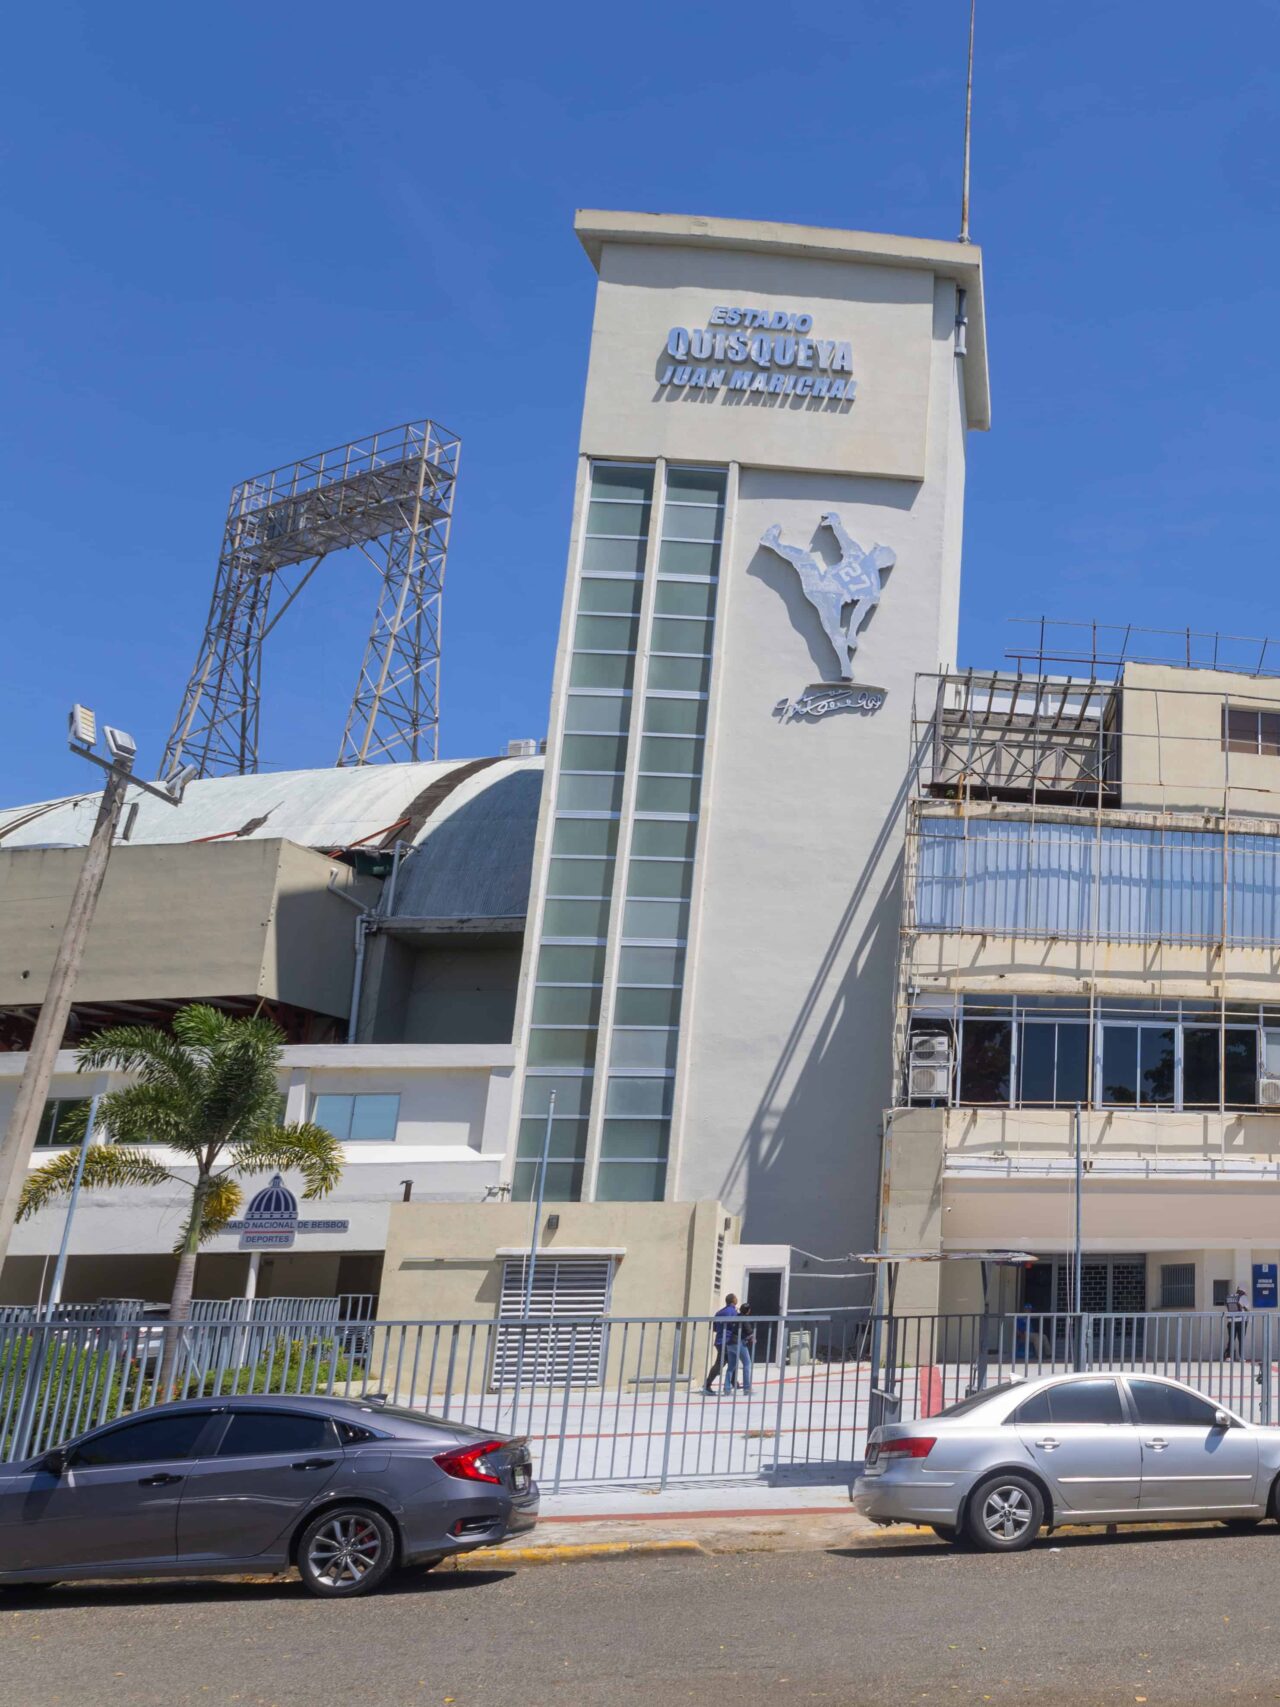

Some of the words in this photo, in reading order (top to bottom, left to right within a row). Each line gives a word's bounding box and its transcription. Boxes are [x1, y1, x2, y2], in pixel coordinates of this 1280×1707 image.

[711, 306, 813, 333] ESTADIO
[667, 326, 854, 373] QUISQUEYA
[660, 365, 727, 388] JUAN
[728, 369, 859, 401] MARICHAL
[838, 562, 871, 591] 27
[252, 1220, 295, 1229] NACIONAL
[297, 1221, 309, 1229] DE
[311, 1220, 348, 1229] BEISBOL
[245, 1235, 290, 1243] DEPORTES
